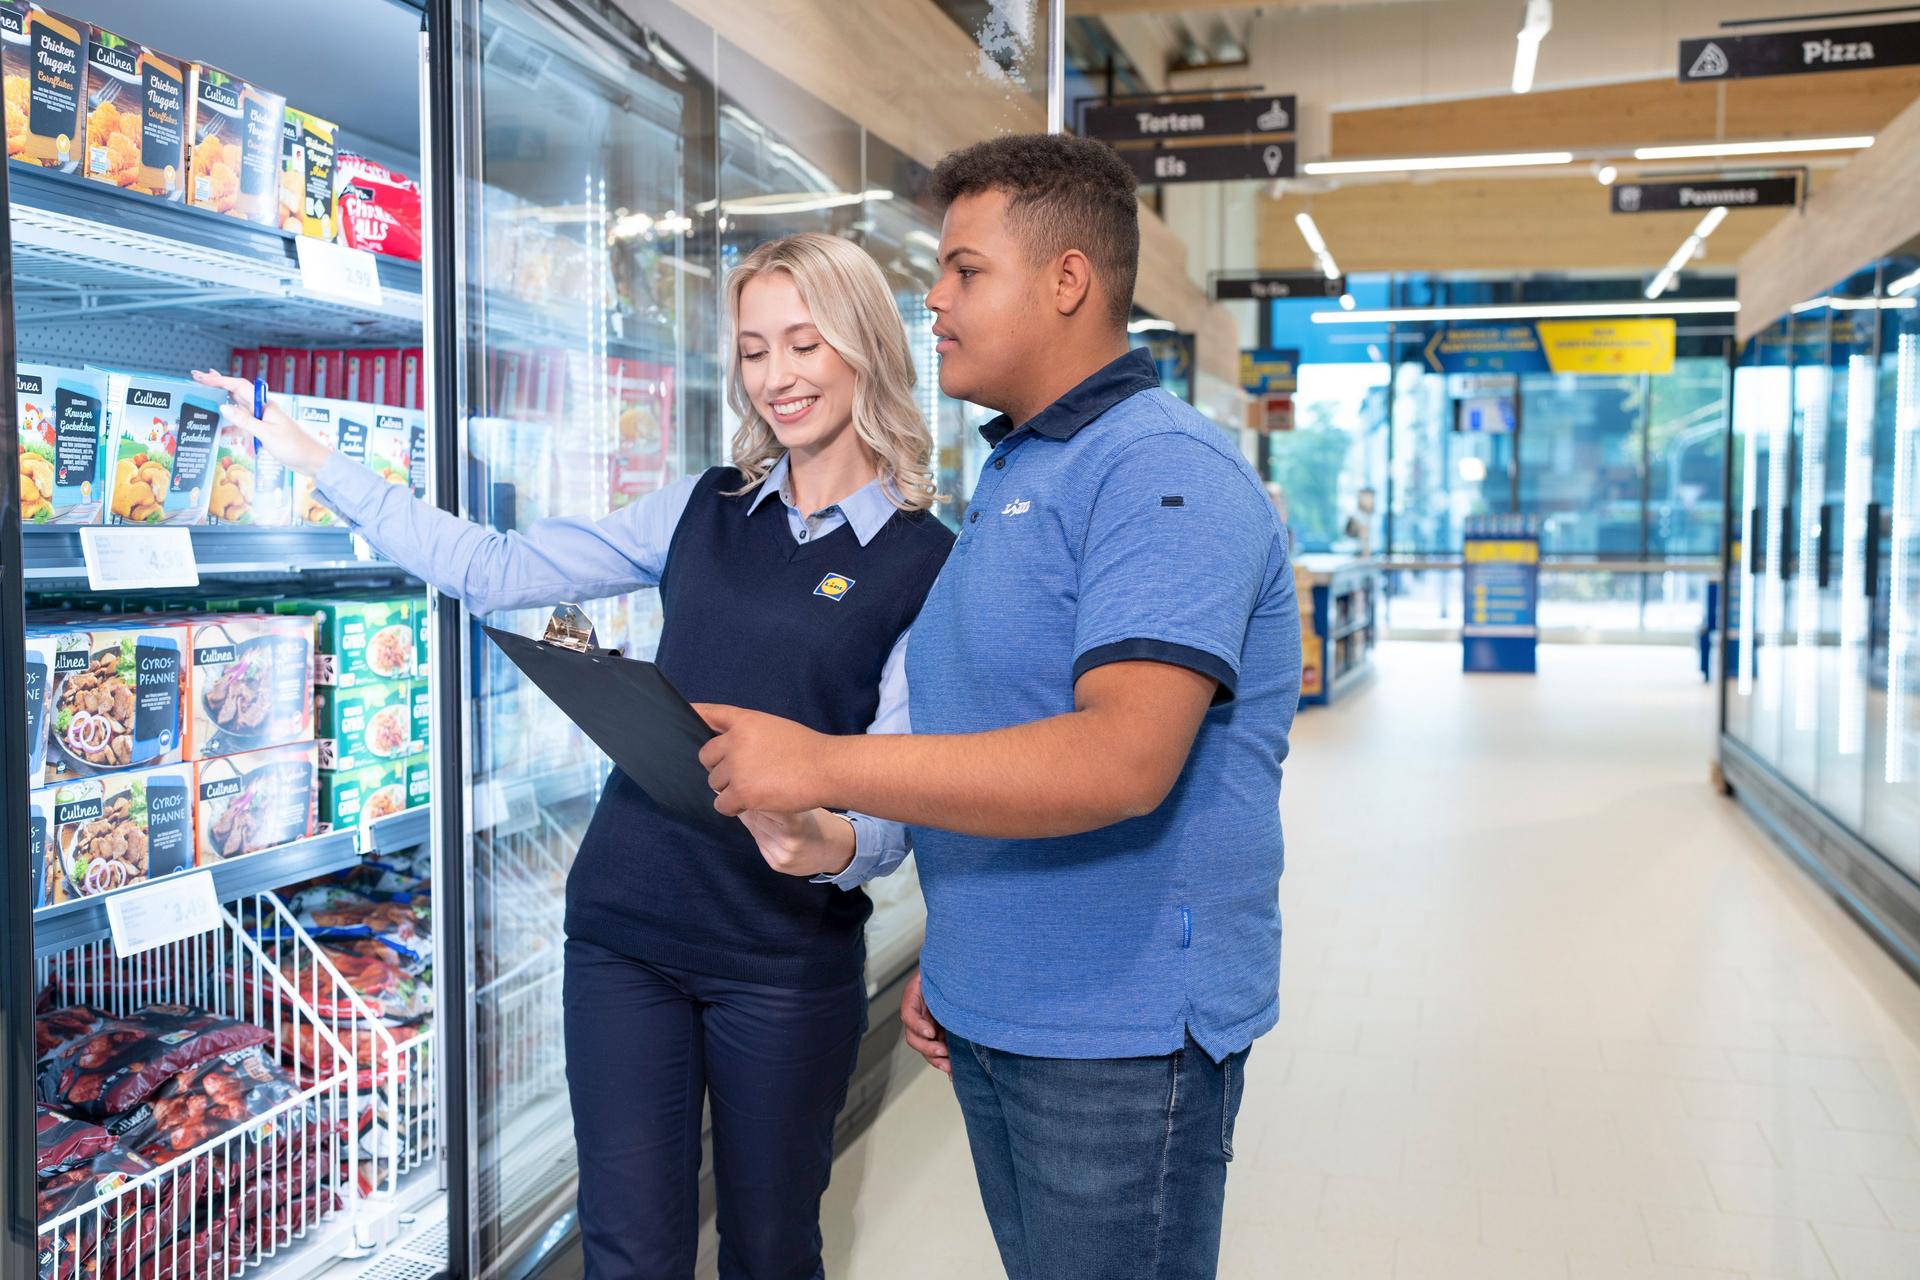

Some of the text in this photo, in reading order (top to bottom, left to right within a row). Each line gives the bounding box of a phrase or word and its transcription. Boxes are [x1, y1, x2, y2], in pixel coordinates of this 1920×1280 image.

[41, 34, 76, 58] Chicken
[1802, 38, 1875, 64] Pizza
[37, 51, 77, 74] Nuggets
[97, 48, 133, 73] Culinea
[37, 70, 74, 91] Cornflakes
[150, 75, 179, 96] Chicken
[148, 89, 180, 111] Nuggets
[204, 85, 236, 107] Culinea
[1136, 112, 1205, 133] Torten
[1155, 155, 1187, 177] Eis
[1679, 186, 1758, 205] Pommes
[134, 391, 168, 407] Culinea
[65, 407, 93, 423] Knusper
[141, 656, 175, 671] GYROS-
[200, 649, 233, 664] Culinea
[139, 671, 176, 686] PFANNE
[206, 780, 240, 798] Culinea
[152, 794, 184, 811] GYROS-
[60, 804, 99, 822] Culinea
[151, 809, 186, 826] PFANNE
